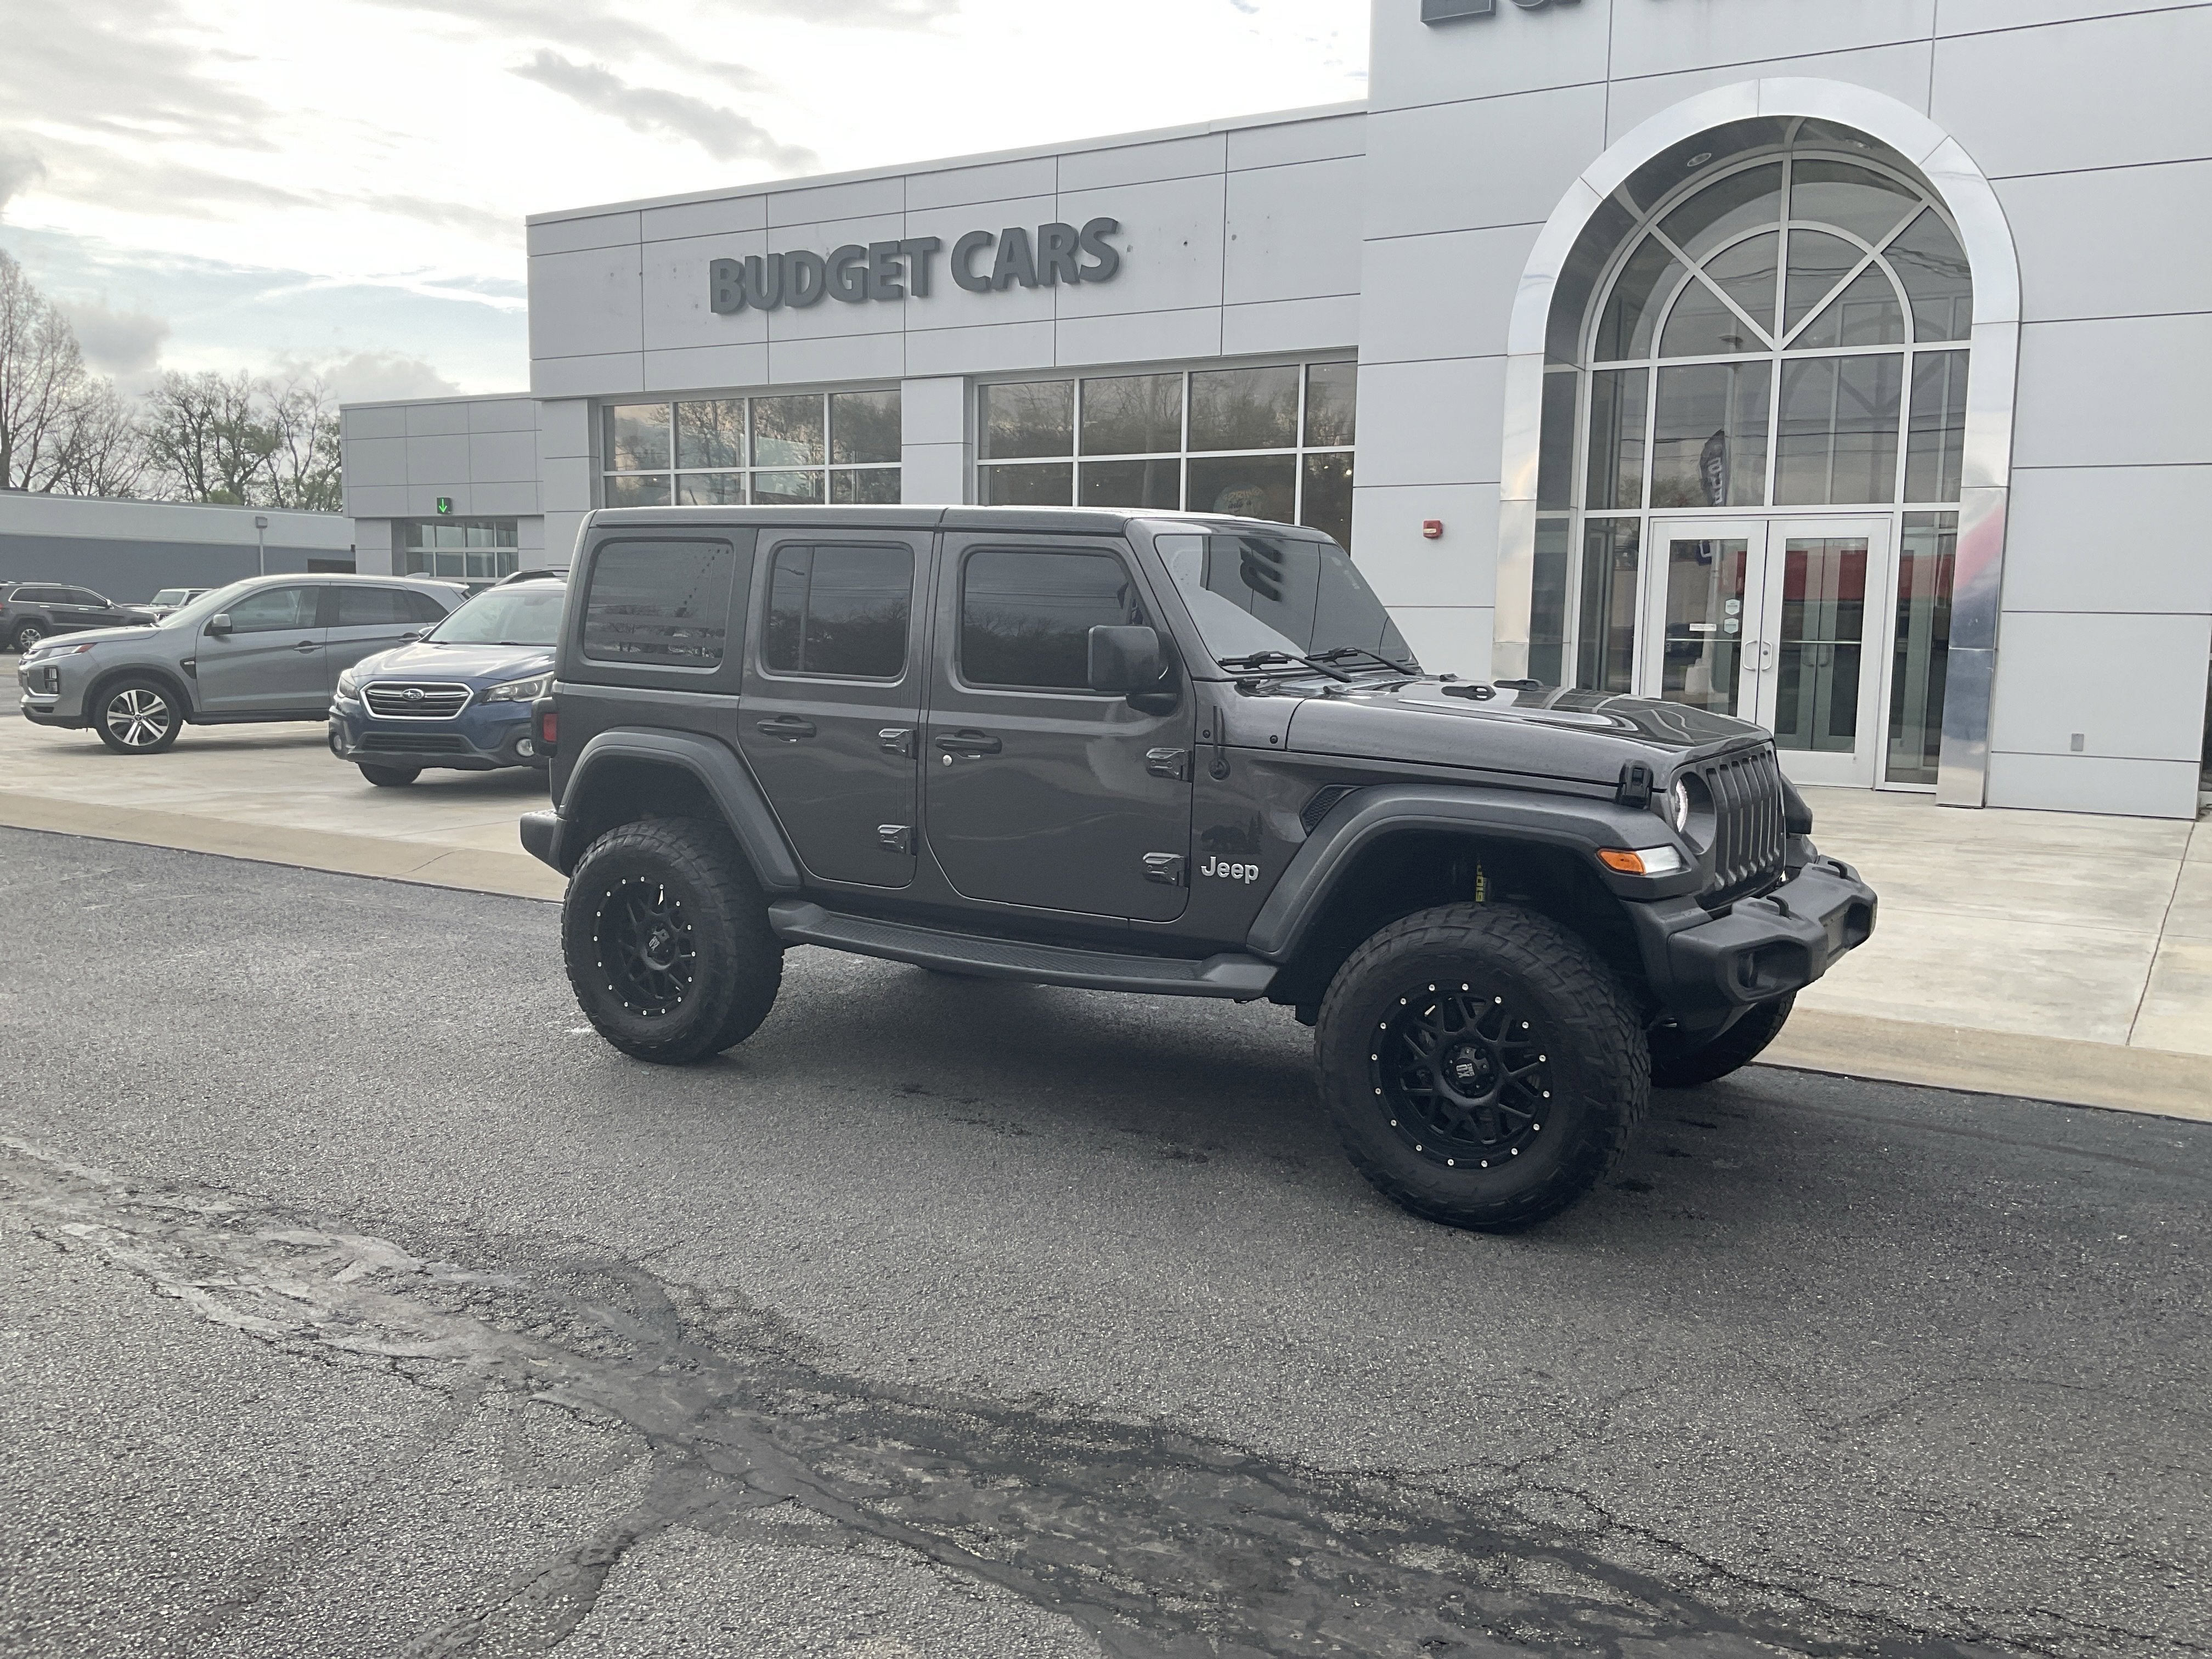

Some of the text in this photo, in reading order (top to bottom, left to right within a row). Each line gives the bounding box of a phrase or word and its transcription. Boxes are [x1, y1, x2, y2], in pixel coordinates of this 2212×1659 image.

[709, 217, 1120, 314] BUDGET CARS
[1200, 856, 1259, 884] Jeep
